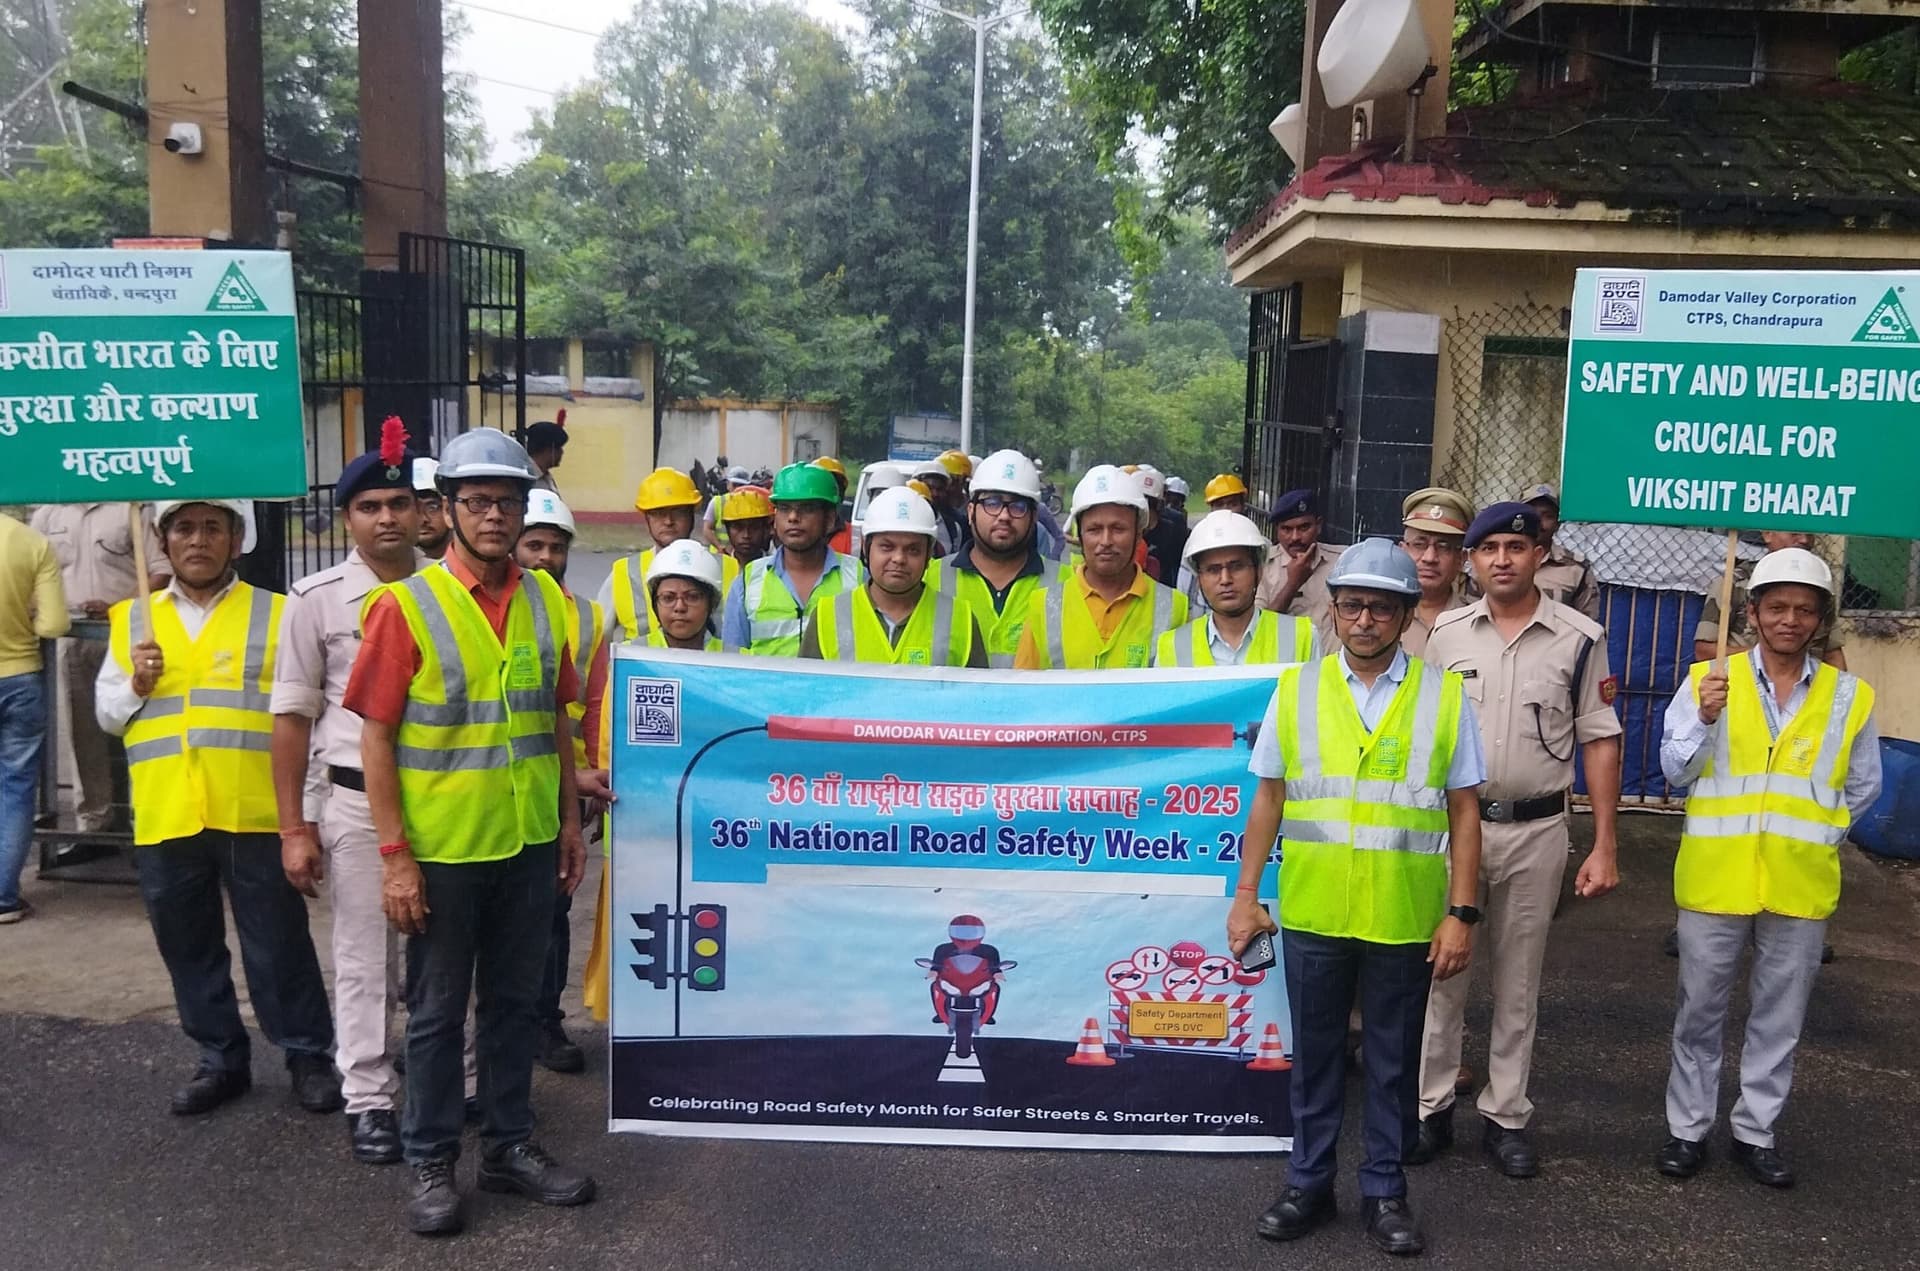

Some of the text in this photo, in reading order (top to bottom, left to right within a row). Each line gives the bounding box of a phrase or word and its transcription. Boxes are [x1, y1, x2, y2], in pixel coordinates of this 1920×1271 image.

[32, 261, 193, 279] दामोदर घाटी निगम
[1602, 290, 1640, 298] DVC
[1659, 291, 1857, 308] Damodar Valley Corporation
[1687, 313, 1823, 329] CTPS, Chandrapura
[0, 329, 279, 370] कसीत भारत के लिए
[1581, 361, 1684, 395] SAFETY
[1690, 364, 1748, 397] AND
[84, 383, 144, 423] और
[149, 393, 259, 421] कल्याण
[1655, 421, 1837, 458] CRUCIAL FOR
[61, 435, 194, 486] महत्वपूर्ण
[1627, 477, 1856, 517] VIKSHIT BHARAT
[635, 694, 674, 704] DVC
[854, 724, 1148, 744] DAMODAR VALLEY CORPORATION, CTPS
[768, 774, 805, 804] 36
[847, 773, 922, 815] राष्ट्रीय
[928, 782, 988, 816] सड़क
[992, 783, 1063, 820] सुरक्षा
[1066, 785, 1141, 818] सप्ताह
[1164, 784, 1241, 816] 2025
[769, 820, 899, 854] National
[909, 823, 987, 857] Road
[998, 826, 1096, 865] Safety
[1104, 829, 1191, 861] Week
[1172, 950, 1203, 960] STOP
[1135, 1008, 1222, 1021] Safety Department
[1153, 1022, 1204, 1033] CTPS DVC
[649, 1096, 1264, 1125] Celebrating Road Safety Month for Safer Streets & Smarter Travels.
